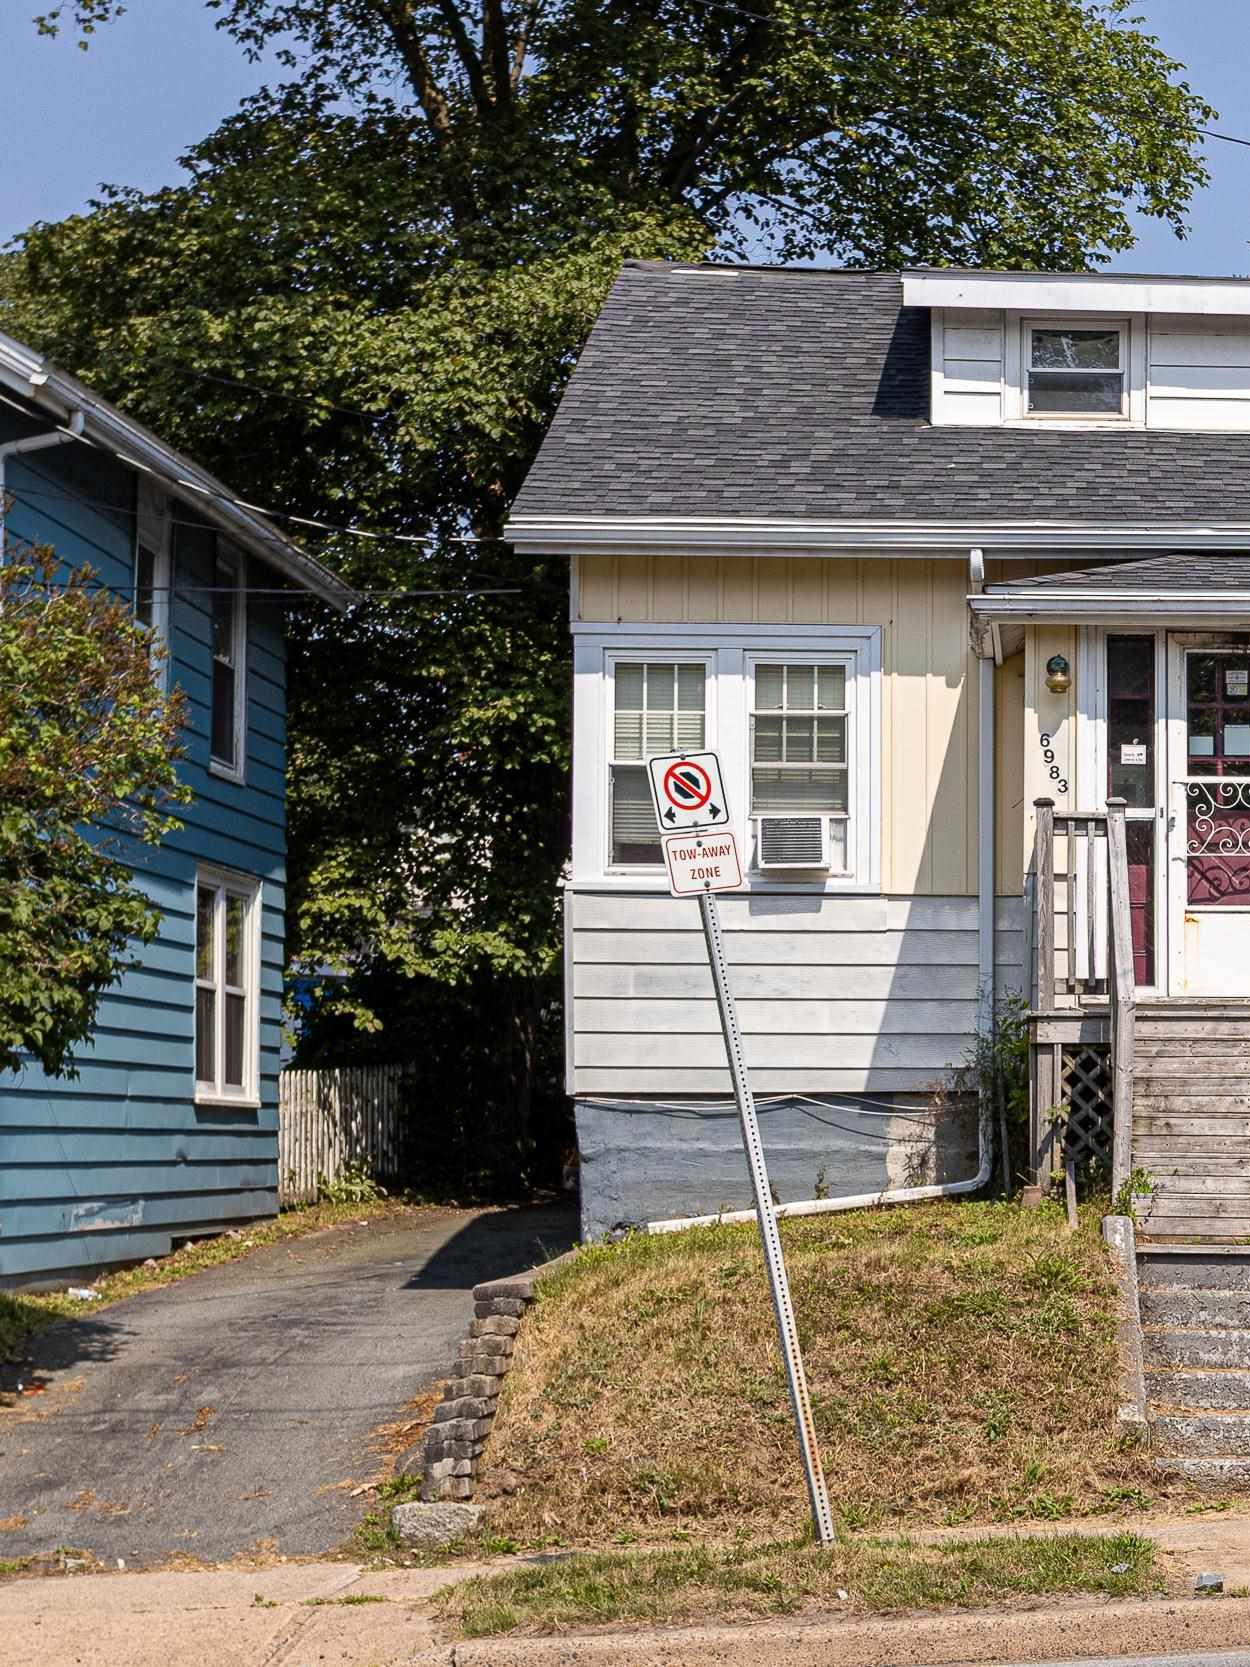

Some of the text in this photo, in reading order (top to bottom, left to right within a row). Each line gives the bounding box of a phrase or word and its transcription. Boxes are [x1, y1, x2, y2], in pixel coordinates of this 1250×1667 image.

[1040, 733, 1069, 793] 6983
[672, 845, 732, 861] TOW-AWAY
[690, 866, 721, 880] ZONE
